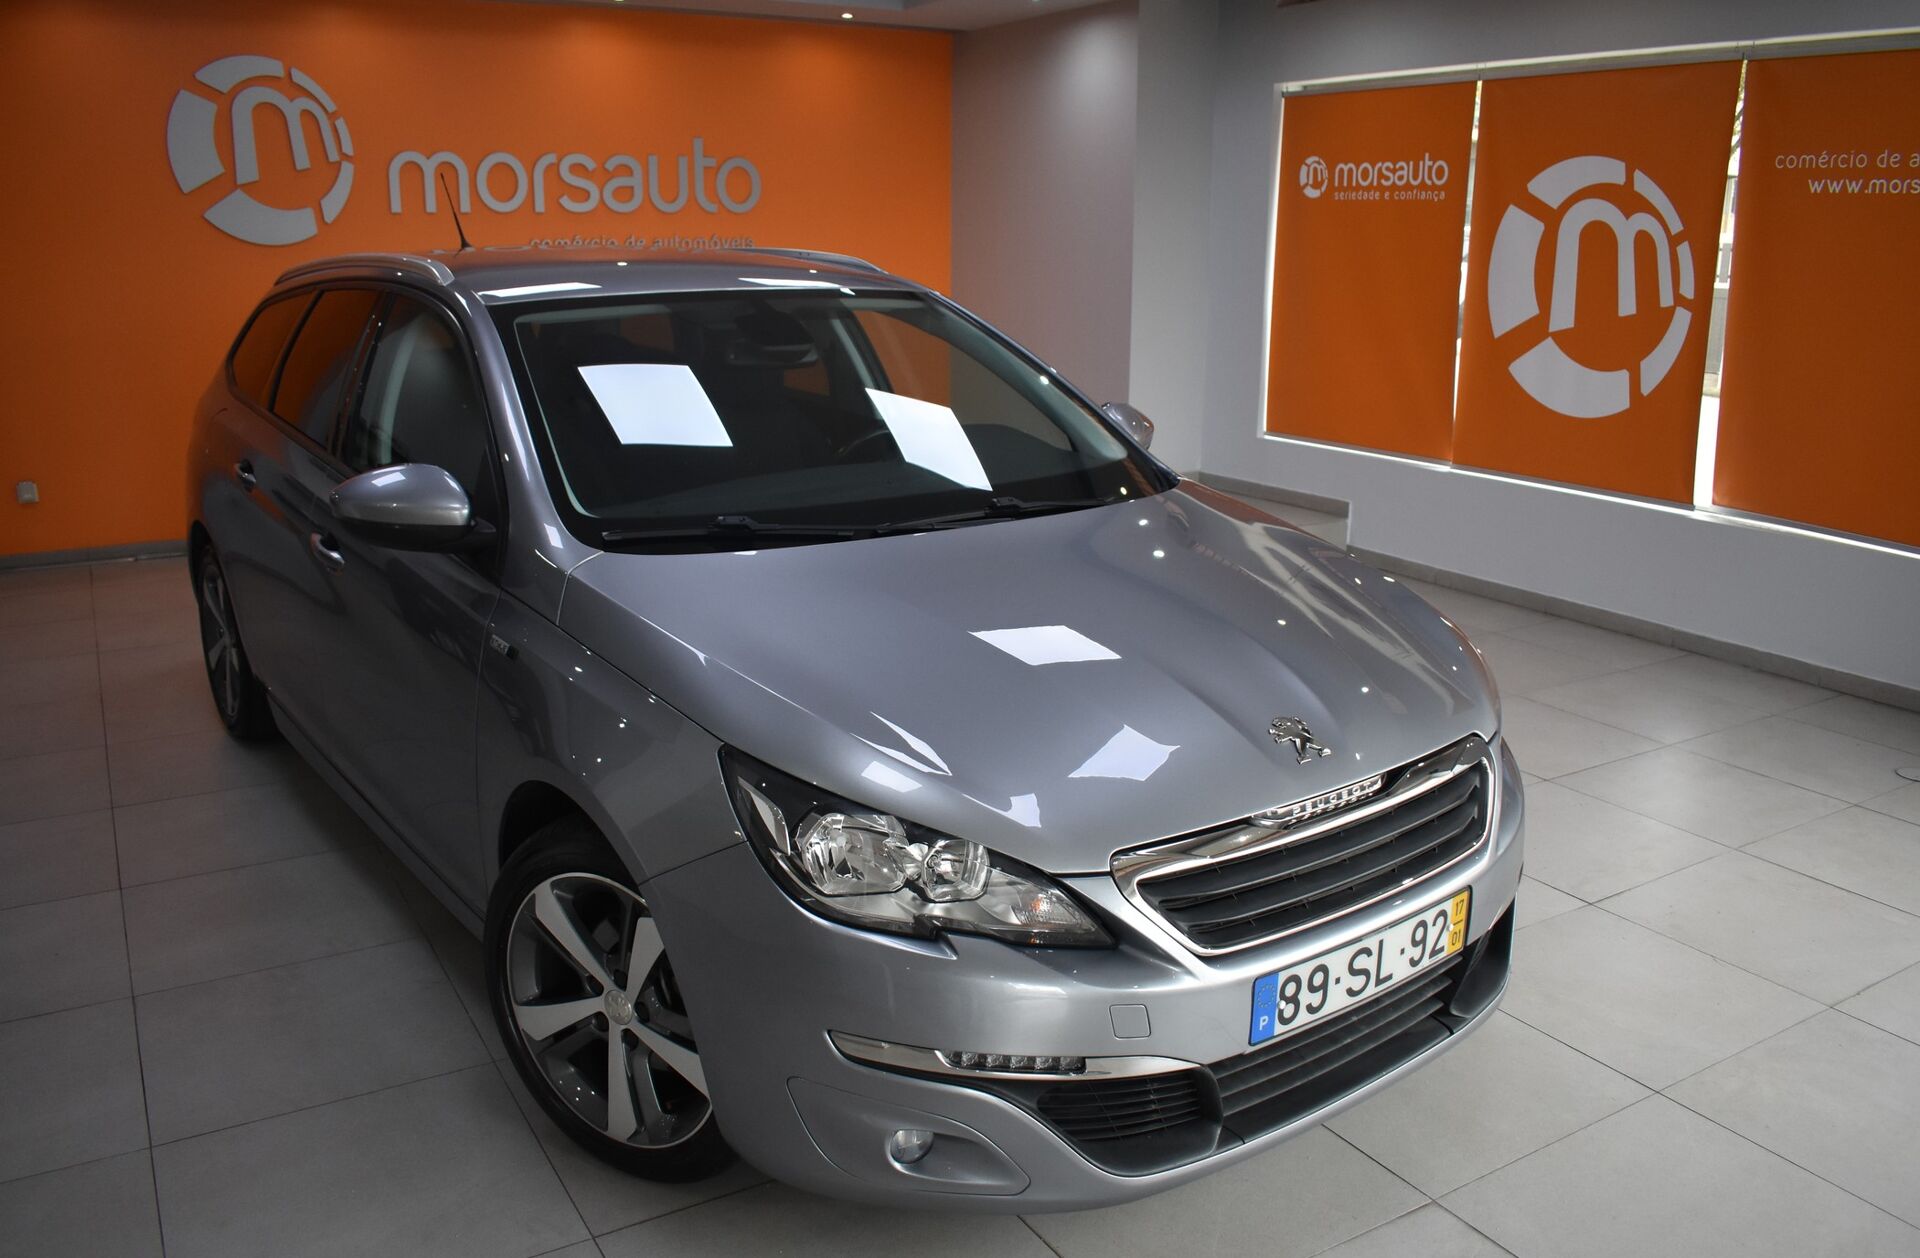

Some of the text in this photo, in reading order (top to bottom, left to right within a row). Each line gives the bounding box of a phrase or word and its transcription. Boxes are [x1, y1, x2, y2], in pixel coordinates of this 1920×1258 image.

[1775, 150, 1868, 169] comércio
[1876, 149, 1901, 168] de
[388, 137, 762, 215] morsauto
[1334, 152, 1449, 188] morsauto
[1334, 188, 1446, 202] seriedade e confiança
[1292, 781, 1371, 817] PEUGEOT
[1455, 898, 1464, 917] 17
[1451, 931, 1461, 947] 01
[1259, 1015, 1269, 1031] P
